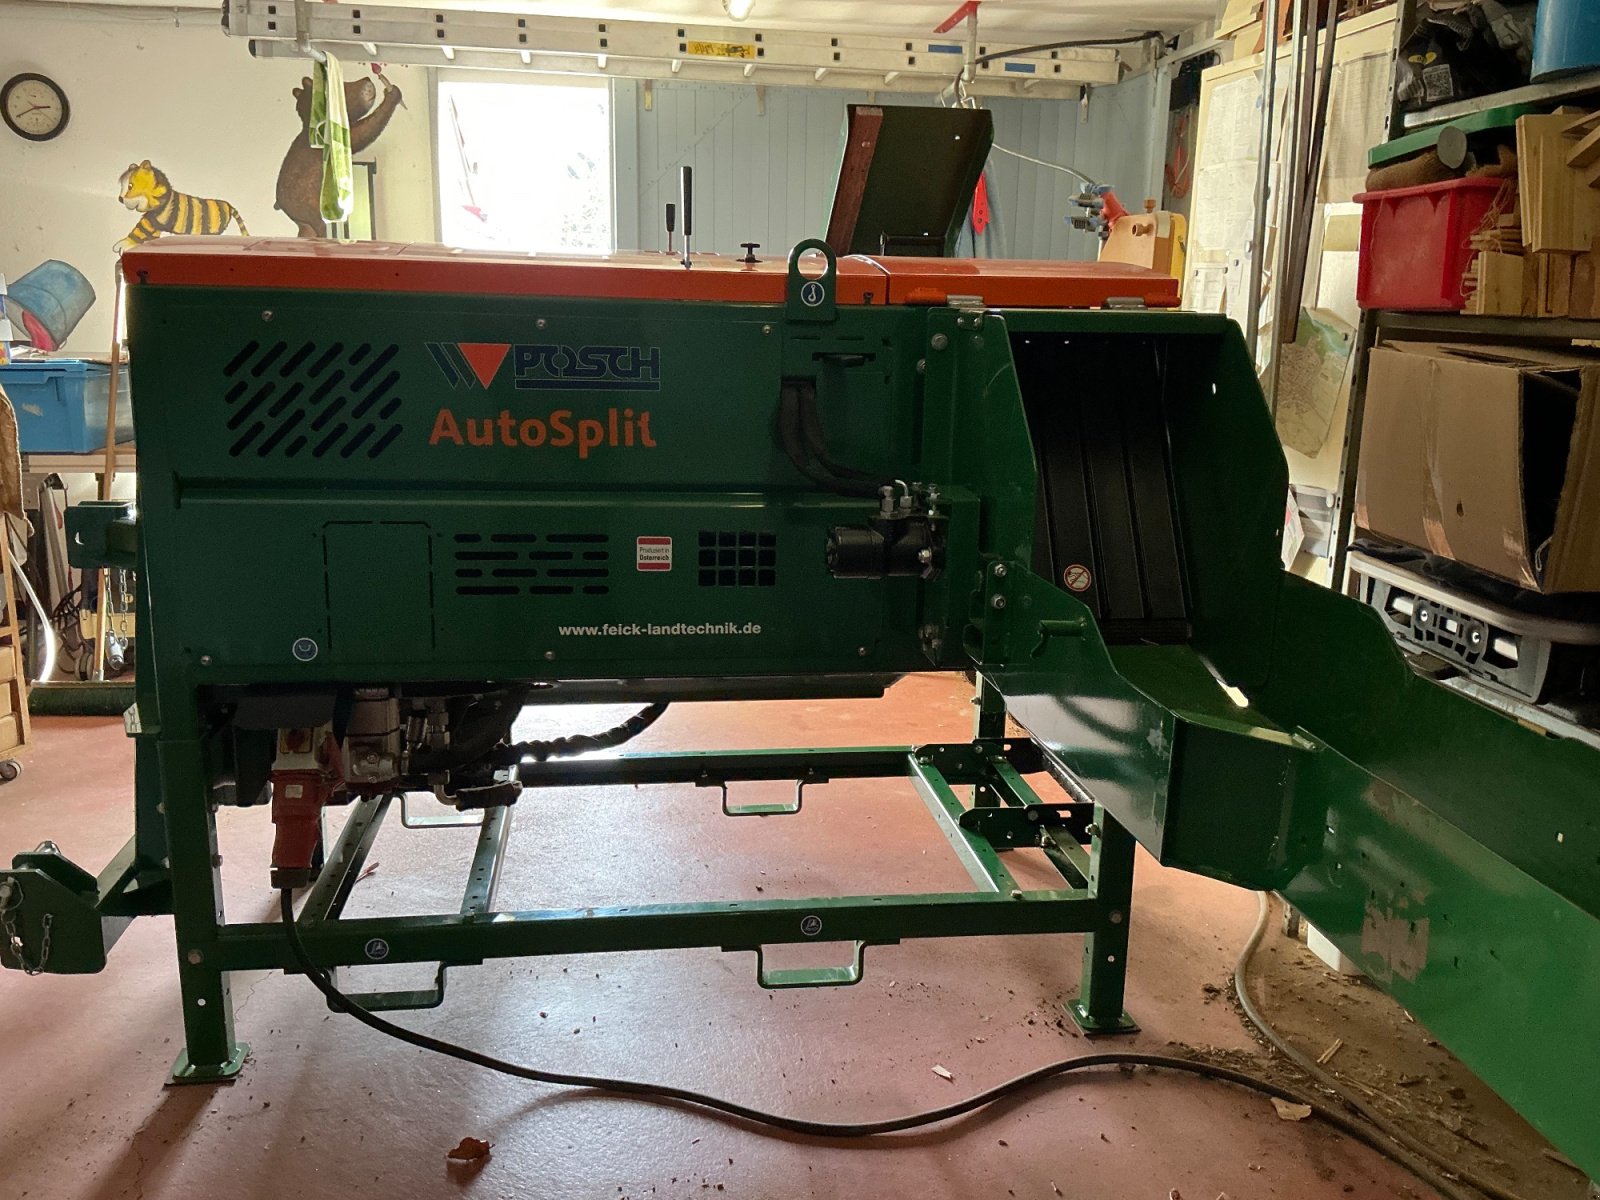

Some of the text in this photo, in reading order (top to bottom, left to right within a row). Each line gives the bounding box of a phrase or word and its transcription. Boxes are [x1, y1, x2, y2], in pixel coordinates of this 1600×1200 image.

[514, 344, 660, 379] POSCH
[429, 408, 656, 459] AutoSplit
[559, 622, 761, 635] www.feick-landtechnik.de
